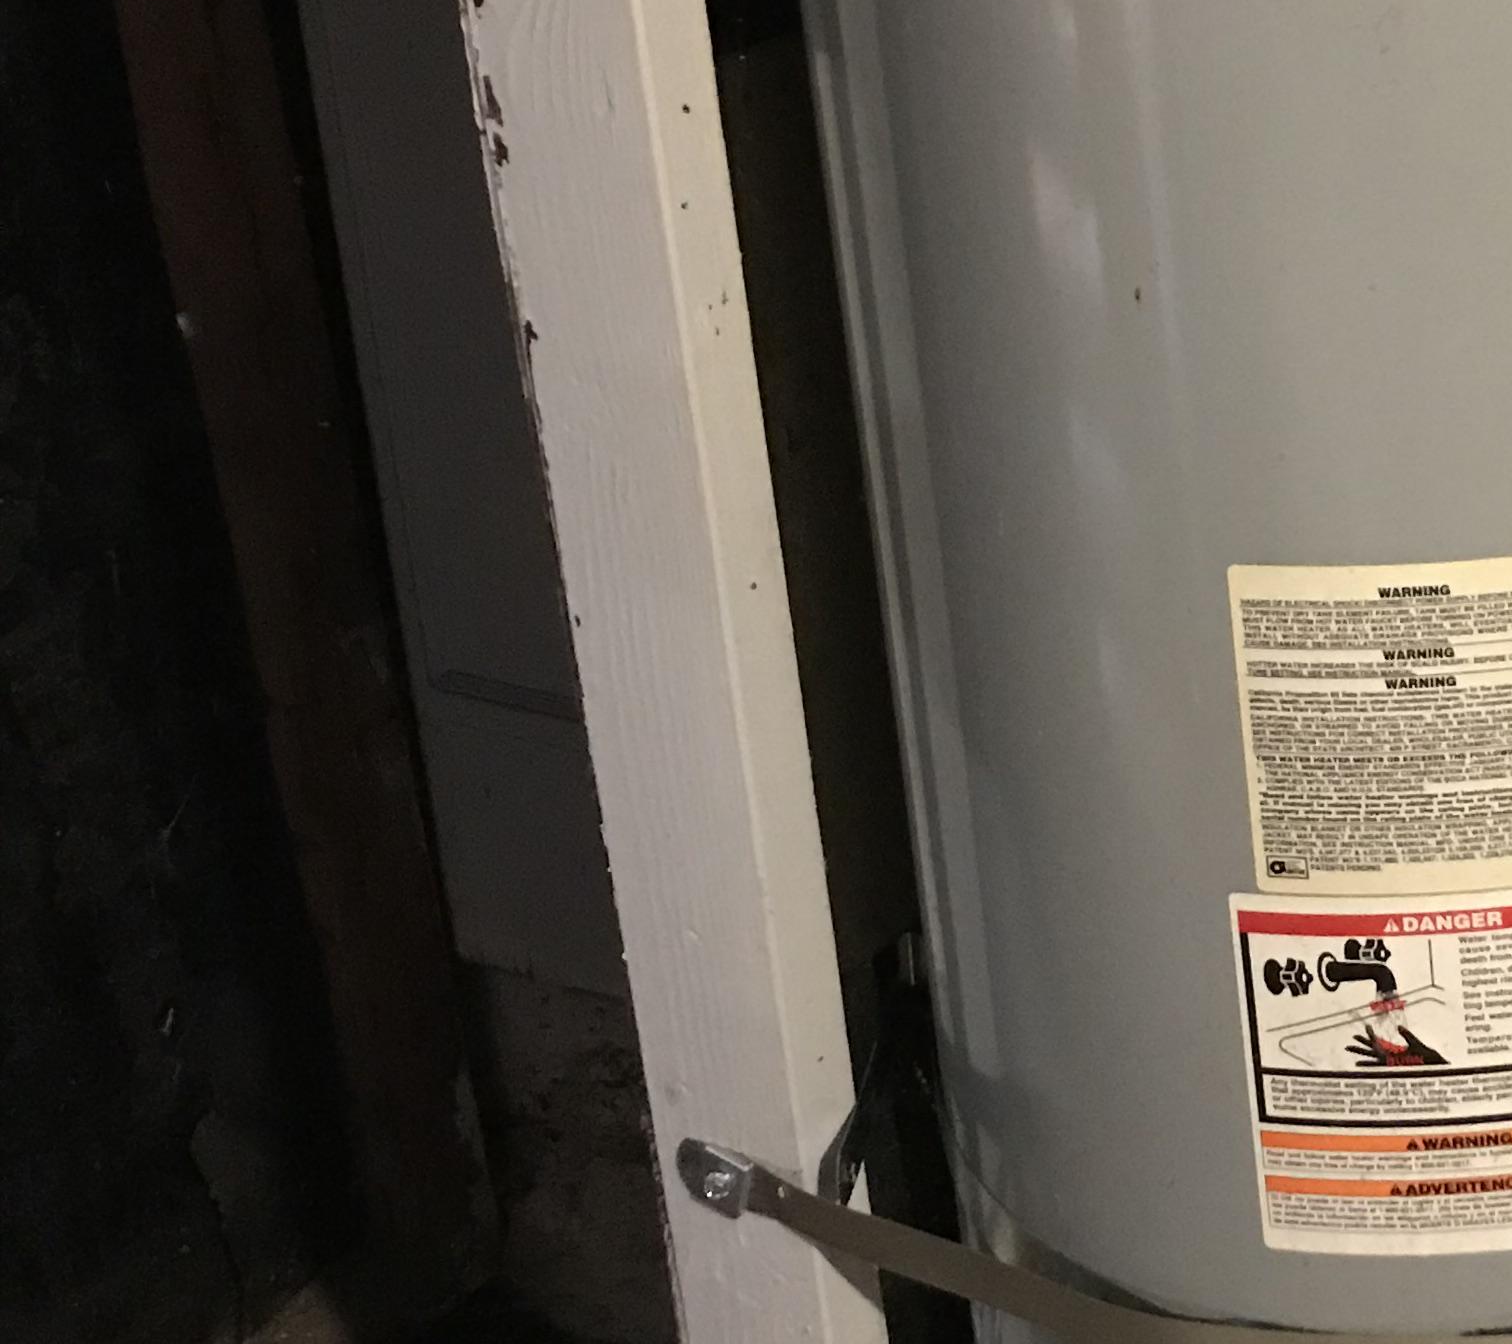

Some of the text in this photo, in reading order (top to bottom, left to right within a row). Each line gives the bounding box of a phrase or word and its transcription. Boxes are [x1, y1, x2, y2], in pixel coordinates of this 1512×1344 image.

[1378, 585, 1451, 598] WARNING
[1383, 647, 1455, 661] WARNING
[1385, 676, 1457, 689] WARNING
[1403, 911, 1502, 932] DANGER
[1422, 1132, 1512, 1150] WARNING
